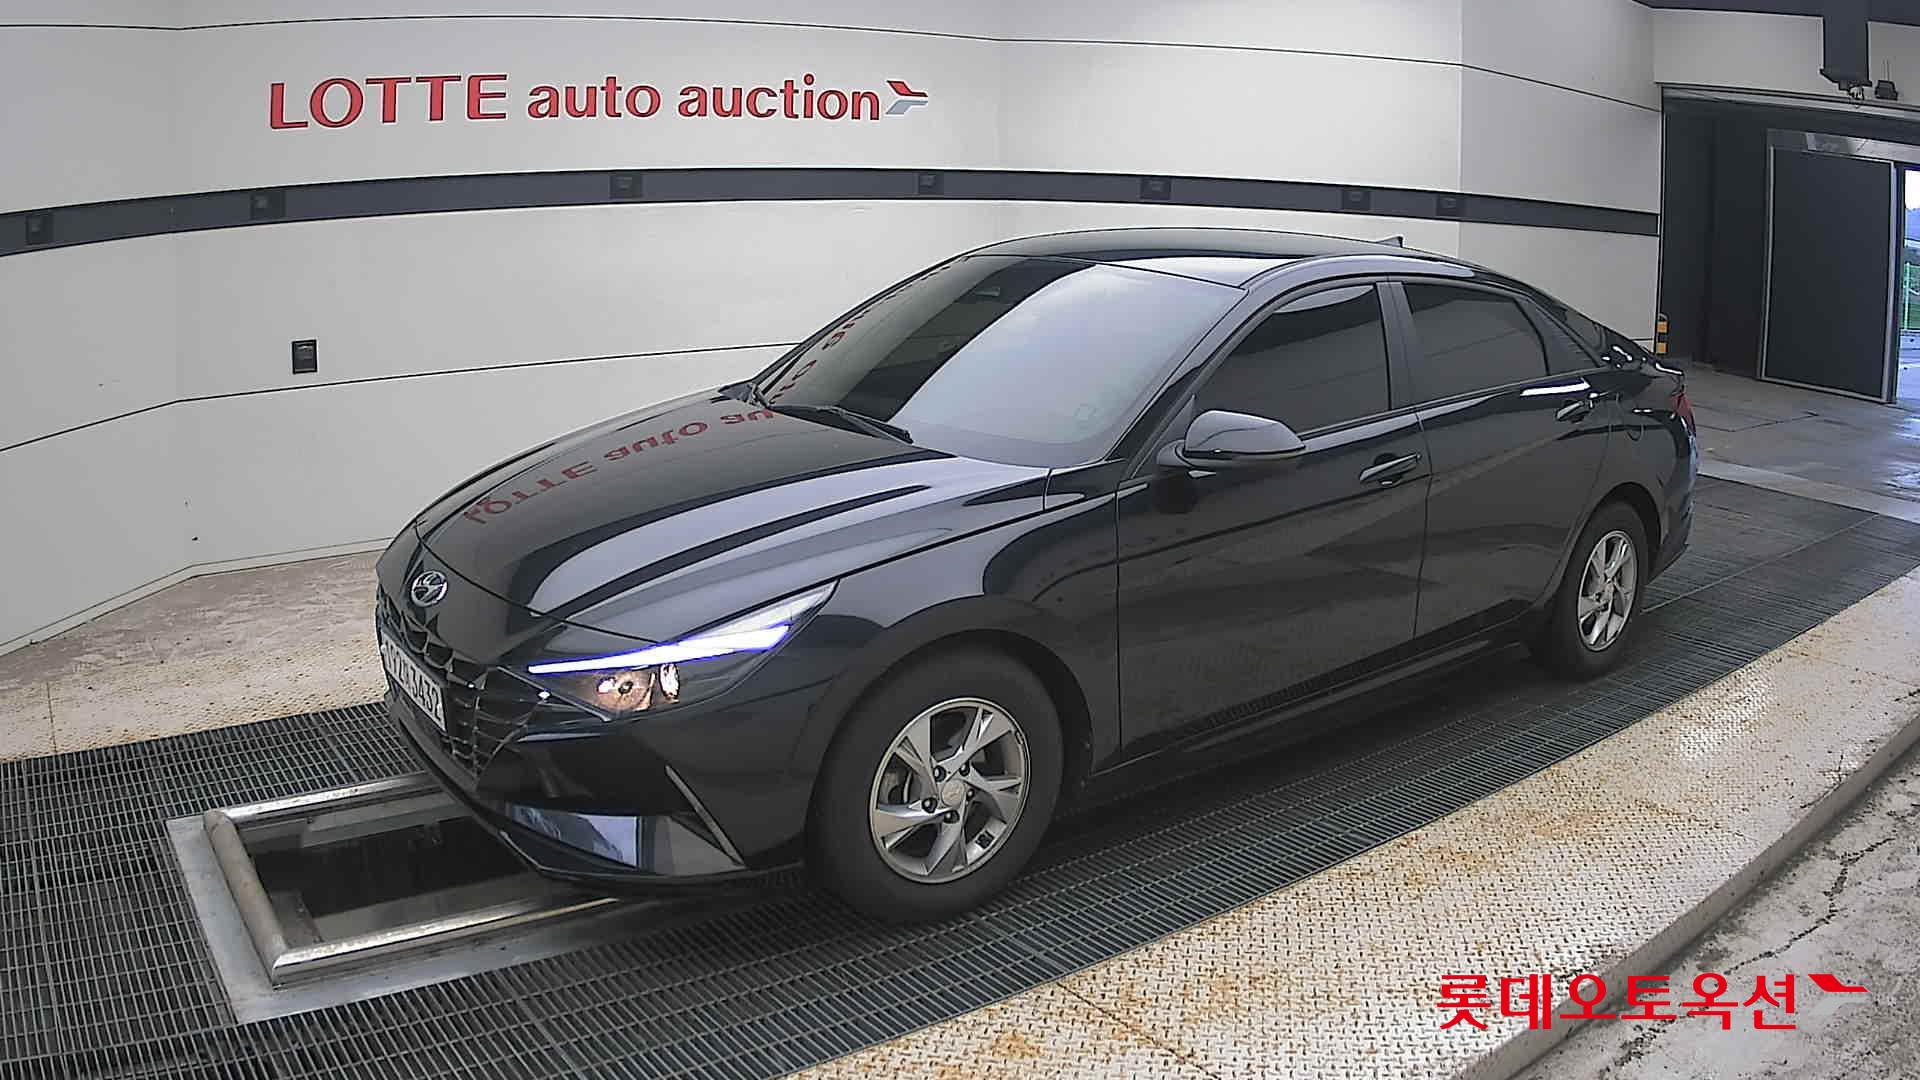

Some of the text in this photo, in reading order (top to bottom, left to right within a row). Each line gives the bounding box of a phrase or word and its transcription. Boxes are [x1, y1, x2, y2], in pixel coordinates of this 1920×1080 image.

[267, 73, 881, 130] LOTTE auto auction
